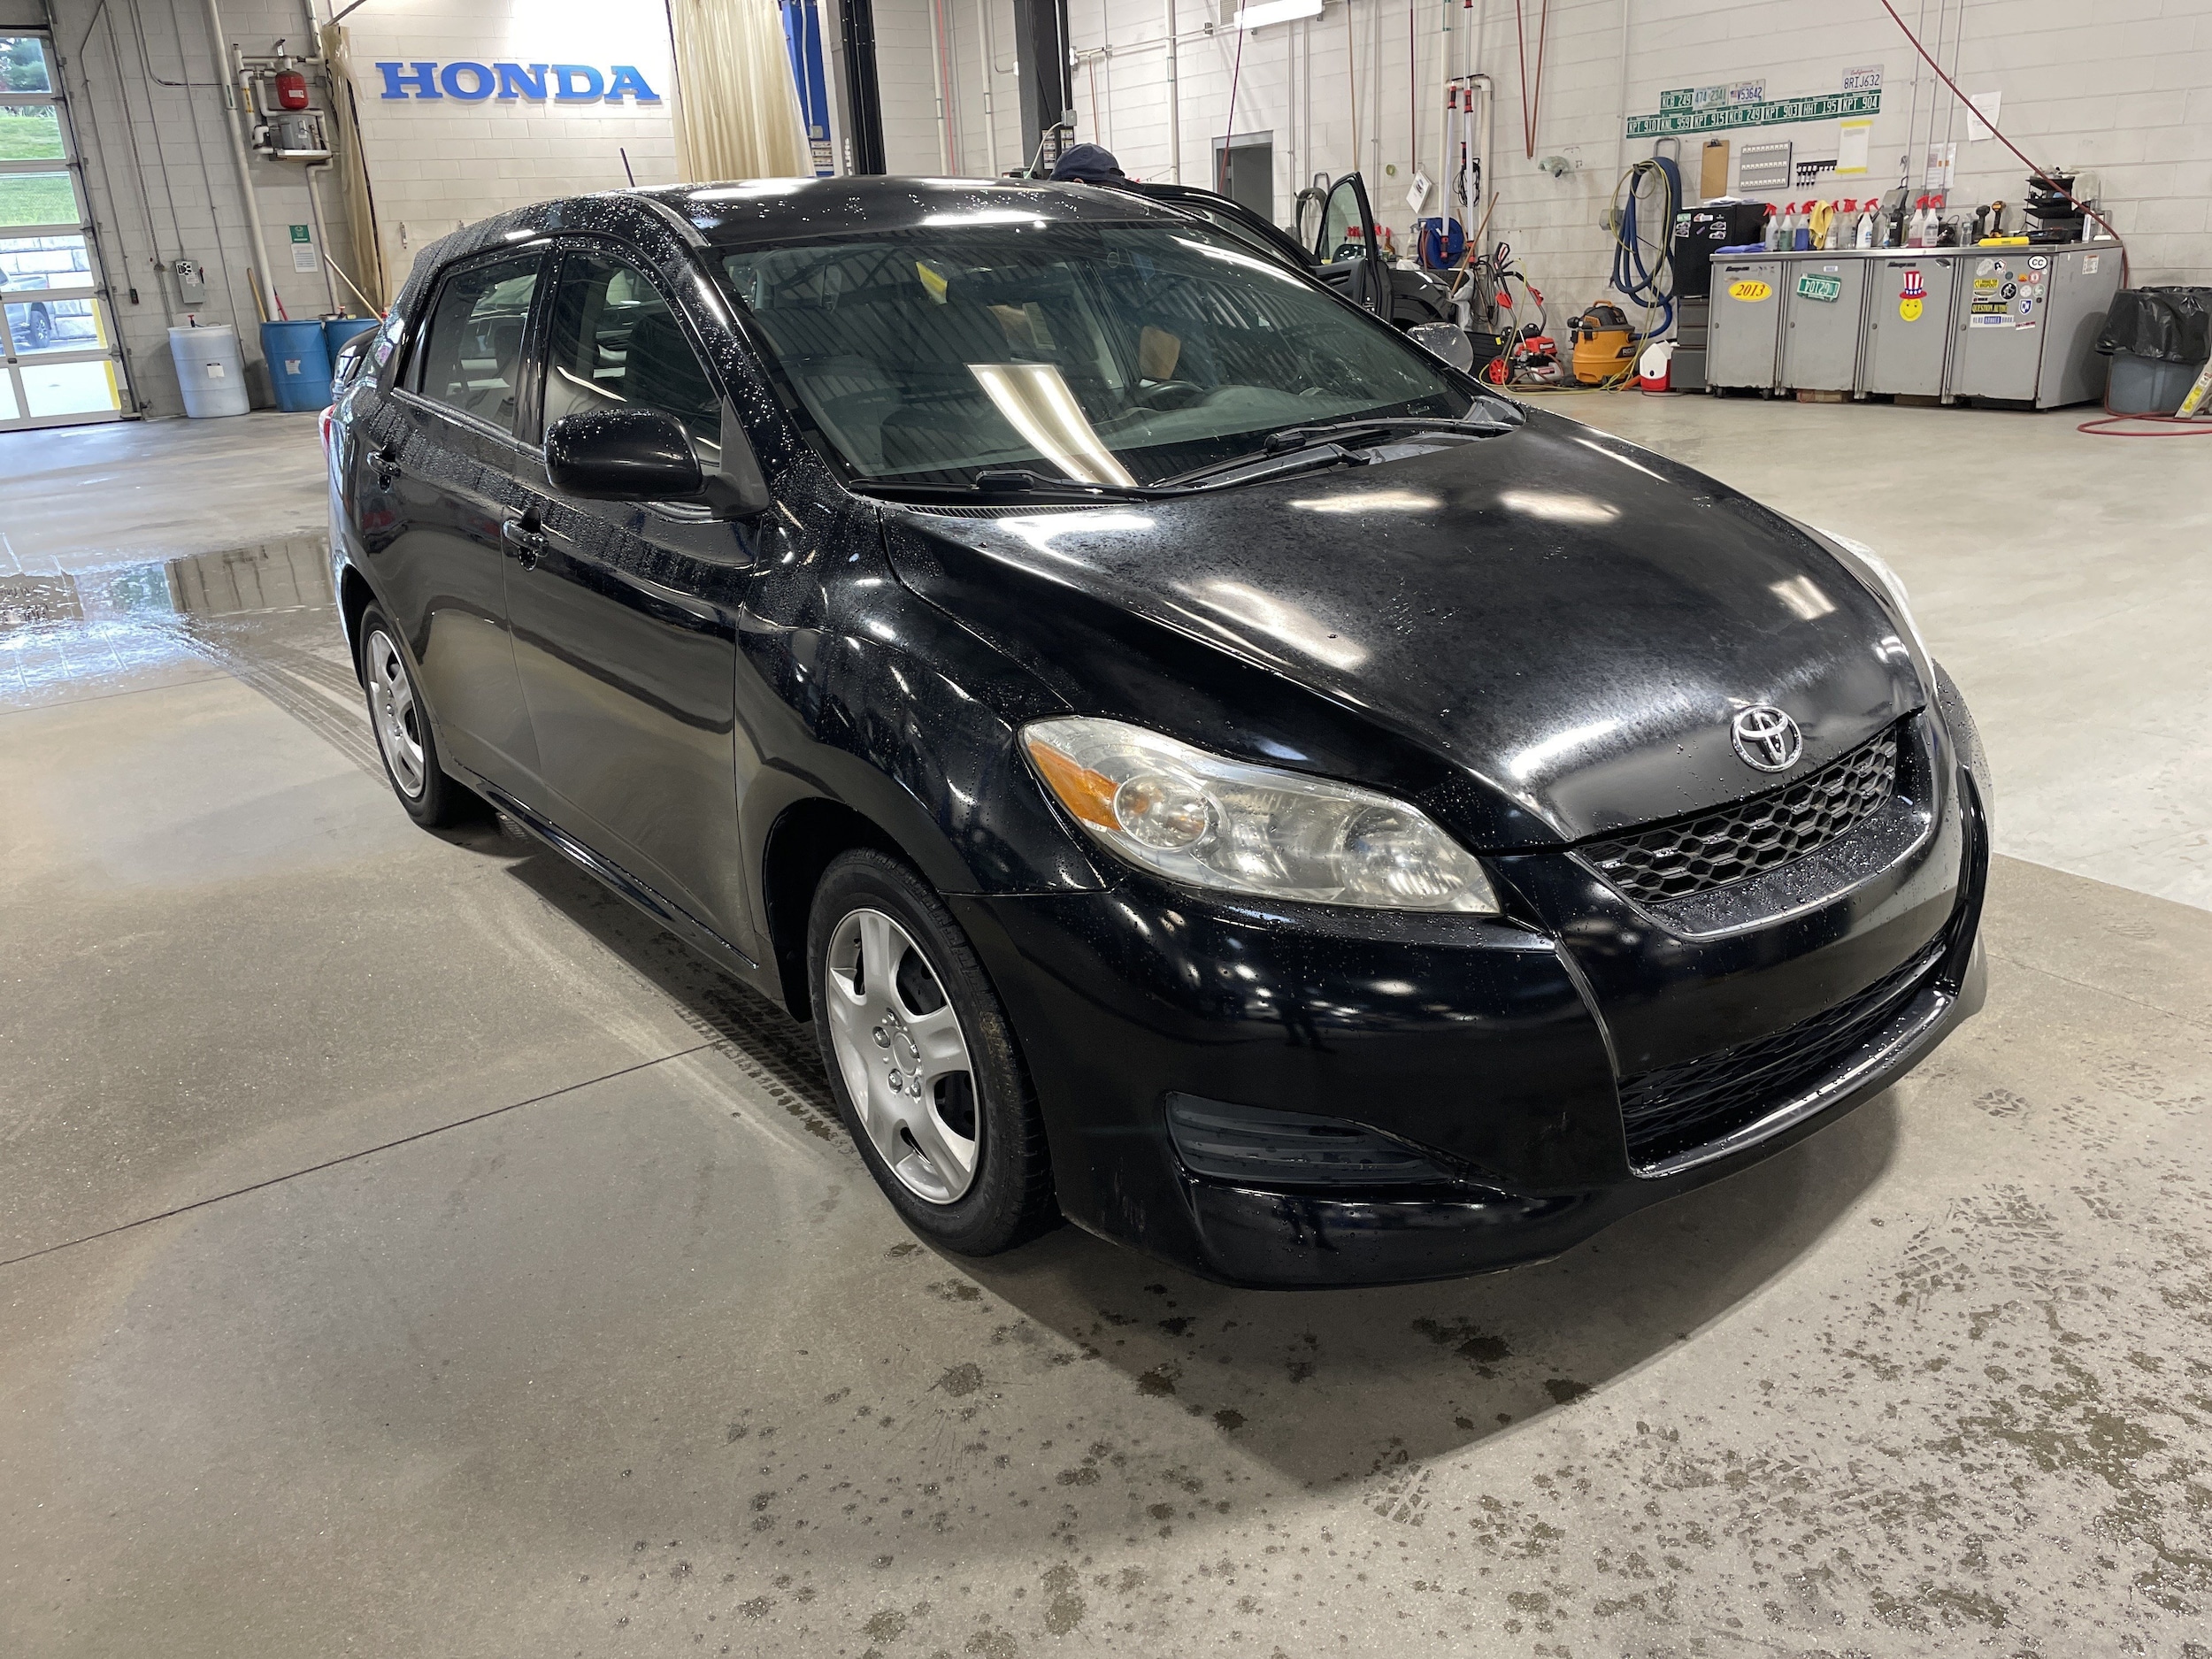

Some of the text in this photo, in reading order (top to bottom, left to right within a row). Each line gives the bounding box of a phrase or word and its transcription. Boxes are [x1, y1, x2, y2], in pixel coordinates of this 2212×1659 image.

[374, 61, 662, 103] HONDA
[1844, 73, 1880, 89] 8RIJ632
[1678, 94, 1692, 106] 249
[1694, 90, 1708, 104] 474
[1736, 86, 1763, 101] V53642
[1802, 100, 1837, 115] HHT 195
[1842, 95, 1878, 111] KPT 904
[1746, 108, 1761, 120] 249
[1764, 104, 1798, 119] KPT 903
[1628, 119, 1657, 134] KPT 910
[1659, 116, 1690, 130] KNL 959
[1694, 112, 1725, 127] KPT 915
[1735, 283, 1766, 297] 2013
